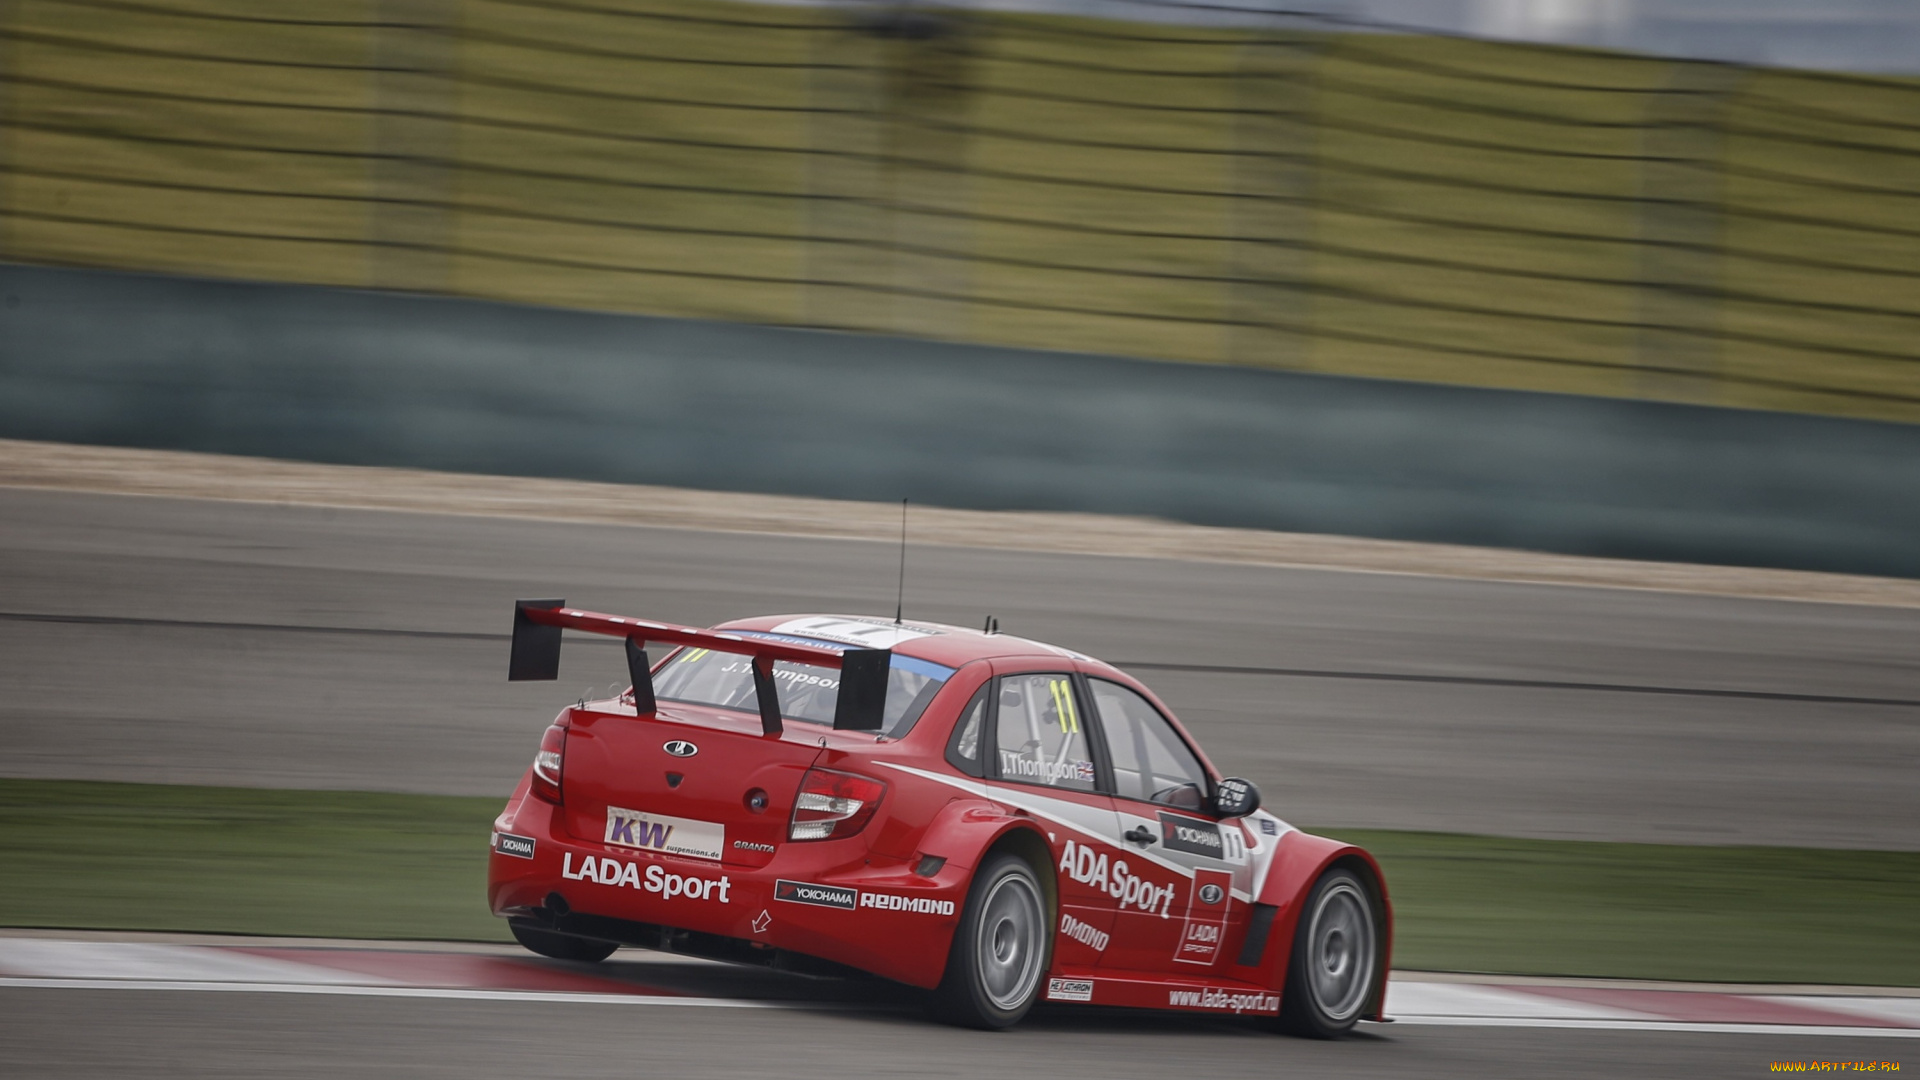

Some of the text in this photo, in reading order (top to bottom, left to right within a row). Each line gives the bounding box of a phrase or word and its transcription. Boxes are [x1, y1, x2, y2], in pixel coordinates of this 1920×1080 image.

[1050, 679, 1078, 733] 11
[1002, 753, 1078, 782] J.Thompson
[610, 816, 674, 849] KW
[1225, 832, 1243, 859] 11
[666, 845, 720, 859] suspensions.de
[733, 840, 775, 853] GRANTA
[562, 852, 731, 903] LADA Sport
[1108, 860, 1175, 919] Sport
[796, 887, 853, 905] YOKOHAMA
[1187, 923, 1219, 943] LADA
[1183, 943, 1216, 953] SPORT
[1169, 988, 1280, 1014] www.lada-sport.ru
